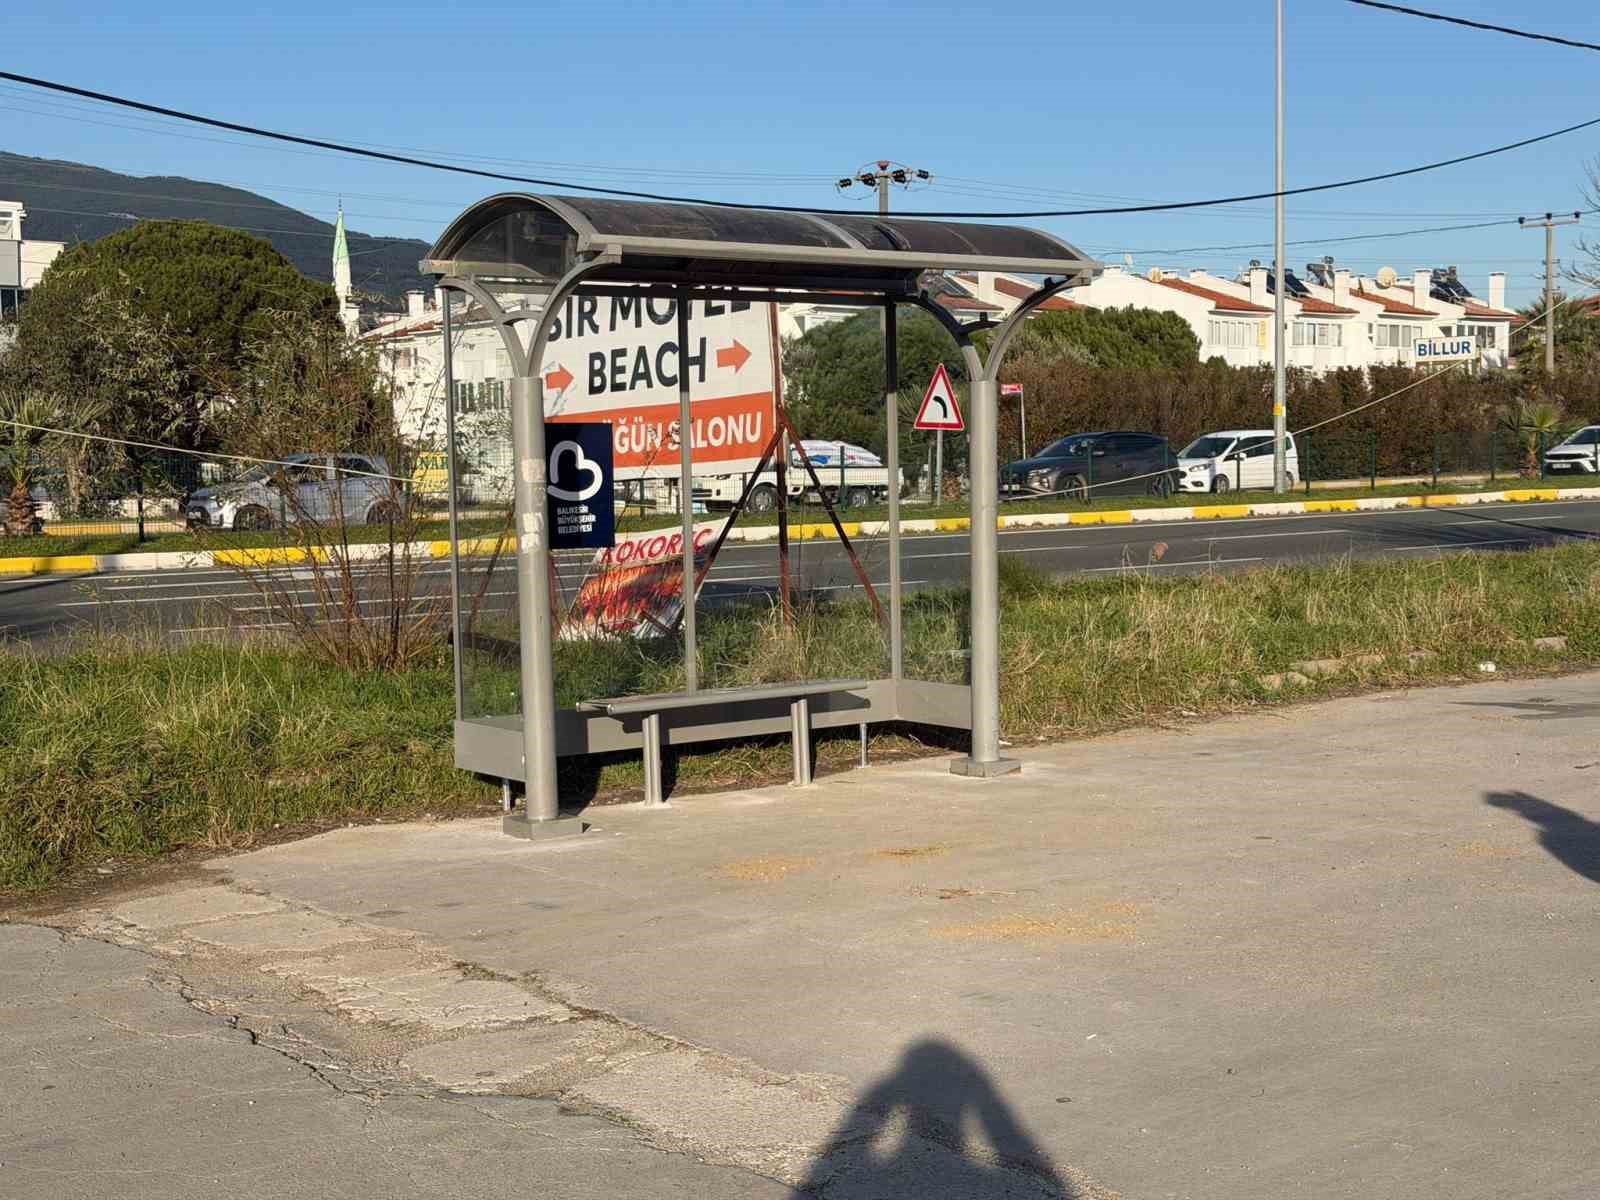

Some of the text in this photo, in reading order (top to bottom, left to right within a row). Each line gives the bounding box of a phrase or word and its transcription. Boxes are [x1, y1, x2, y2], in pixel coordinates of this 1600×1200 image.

[588, 336, 707, 395] BEACH
[1417, 339, 1472, 357] BİLLUR
[602, 411, 762, 454] ĞÜN SLONU
